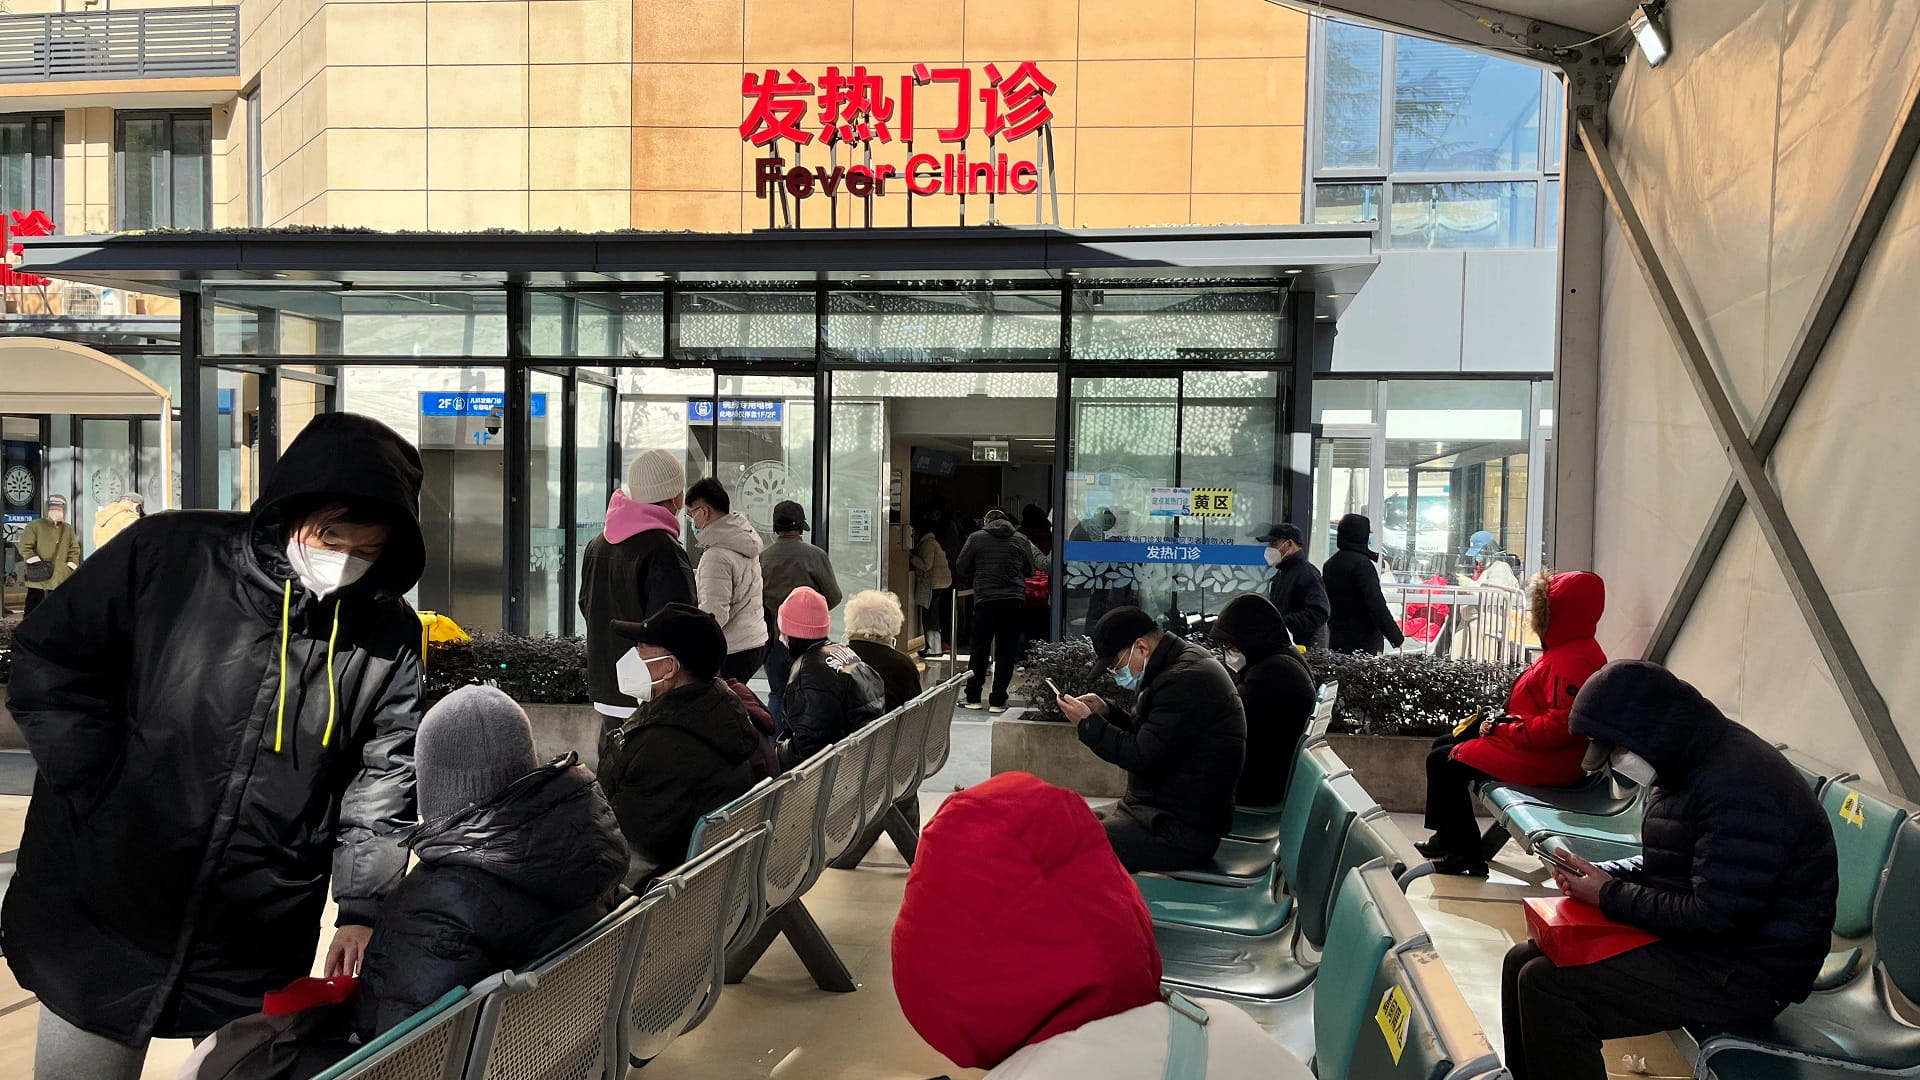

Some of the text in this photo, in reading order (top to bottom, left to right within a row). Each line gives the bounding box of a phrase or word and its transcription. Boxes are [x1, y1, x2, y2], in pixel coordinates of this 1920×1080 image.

[738, 61, 1057, 146] 发热门诊
[755, 153, 1039, 199] Fever Clinic
[438, 398, 452, 409] 2F
[1194, 494, 1229, 510] 黄区
[1146, 545, 1201, 561] 发热门诊
